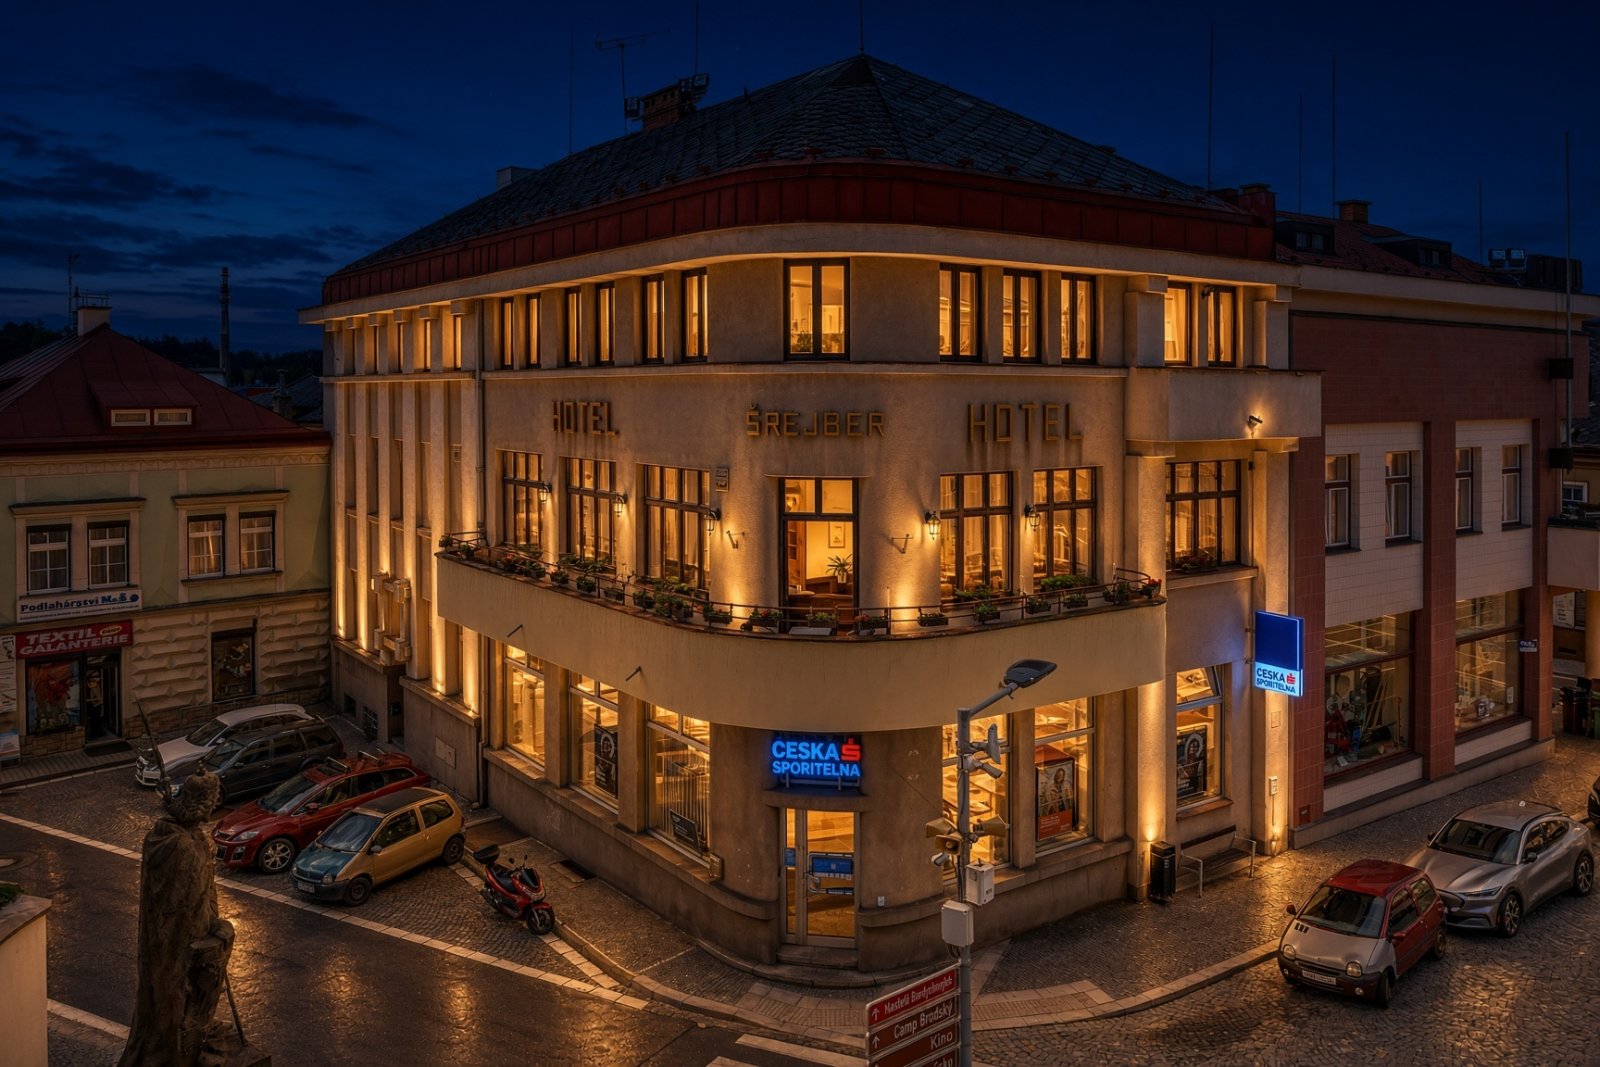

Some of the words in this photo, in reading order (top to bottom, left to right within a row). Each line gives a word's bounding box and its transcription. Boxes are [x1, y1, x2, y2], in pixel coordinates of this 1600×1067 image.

[552, 400, 619, 436] HOTEL
[745, 402, 886, 437] ŠREJBER
[966, 403, 1084, 443] HOTEL
[19, 634, 129, 655] GALANTERIE
[26, 627, 97, 645] TEXTIL
[772, 760, 861, 777] SPORITELNA
[893, 1019, 918, 1039] Camp
[930, 1031, 953, 1050] Kino
